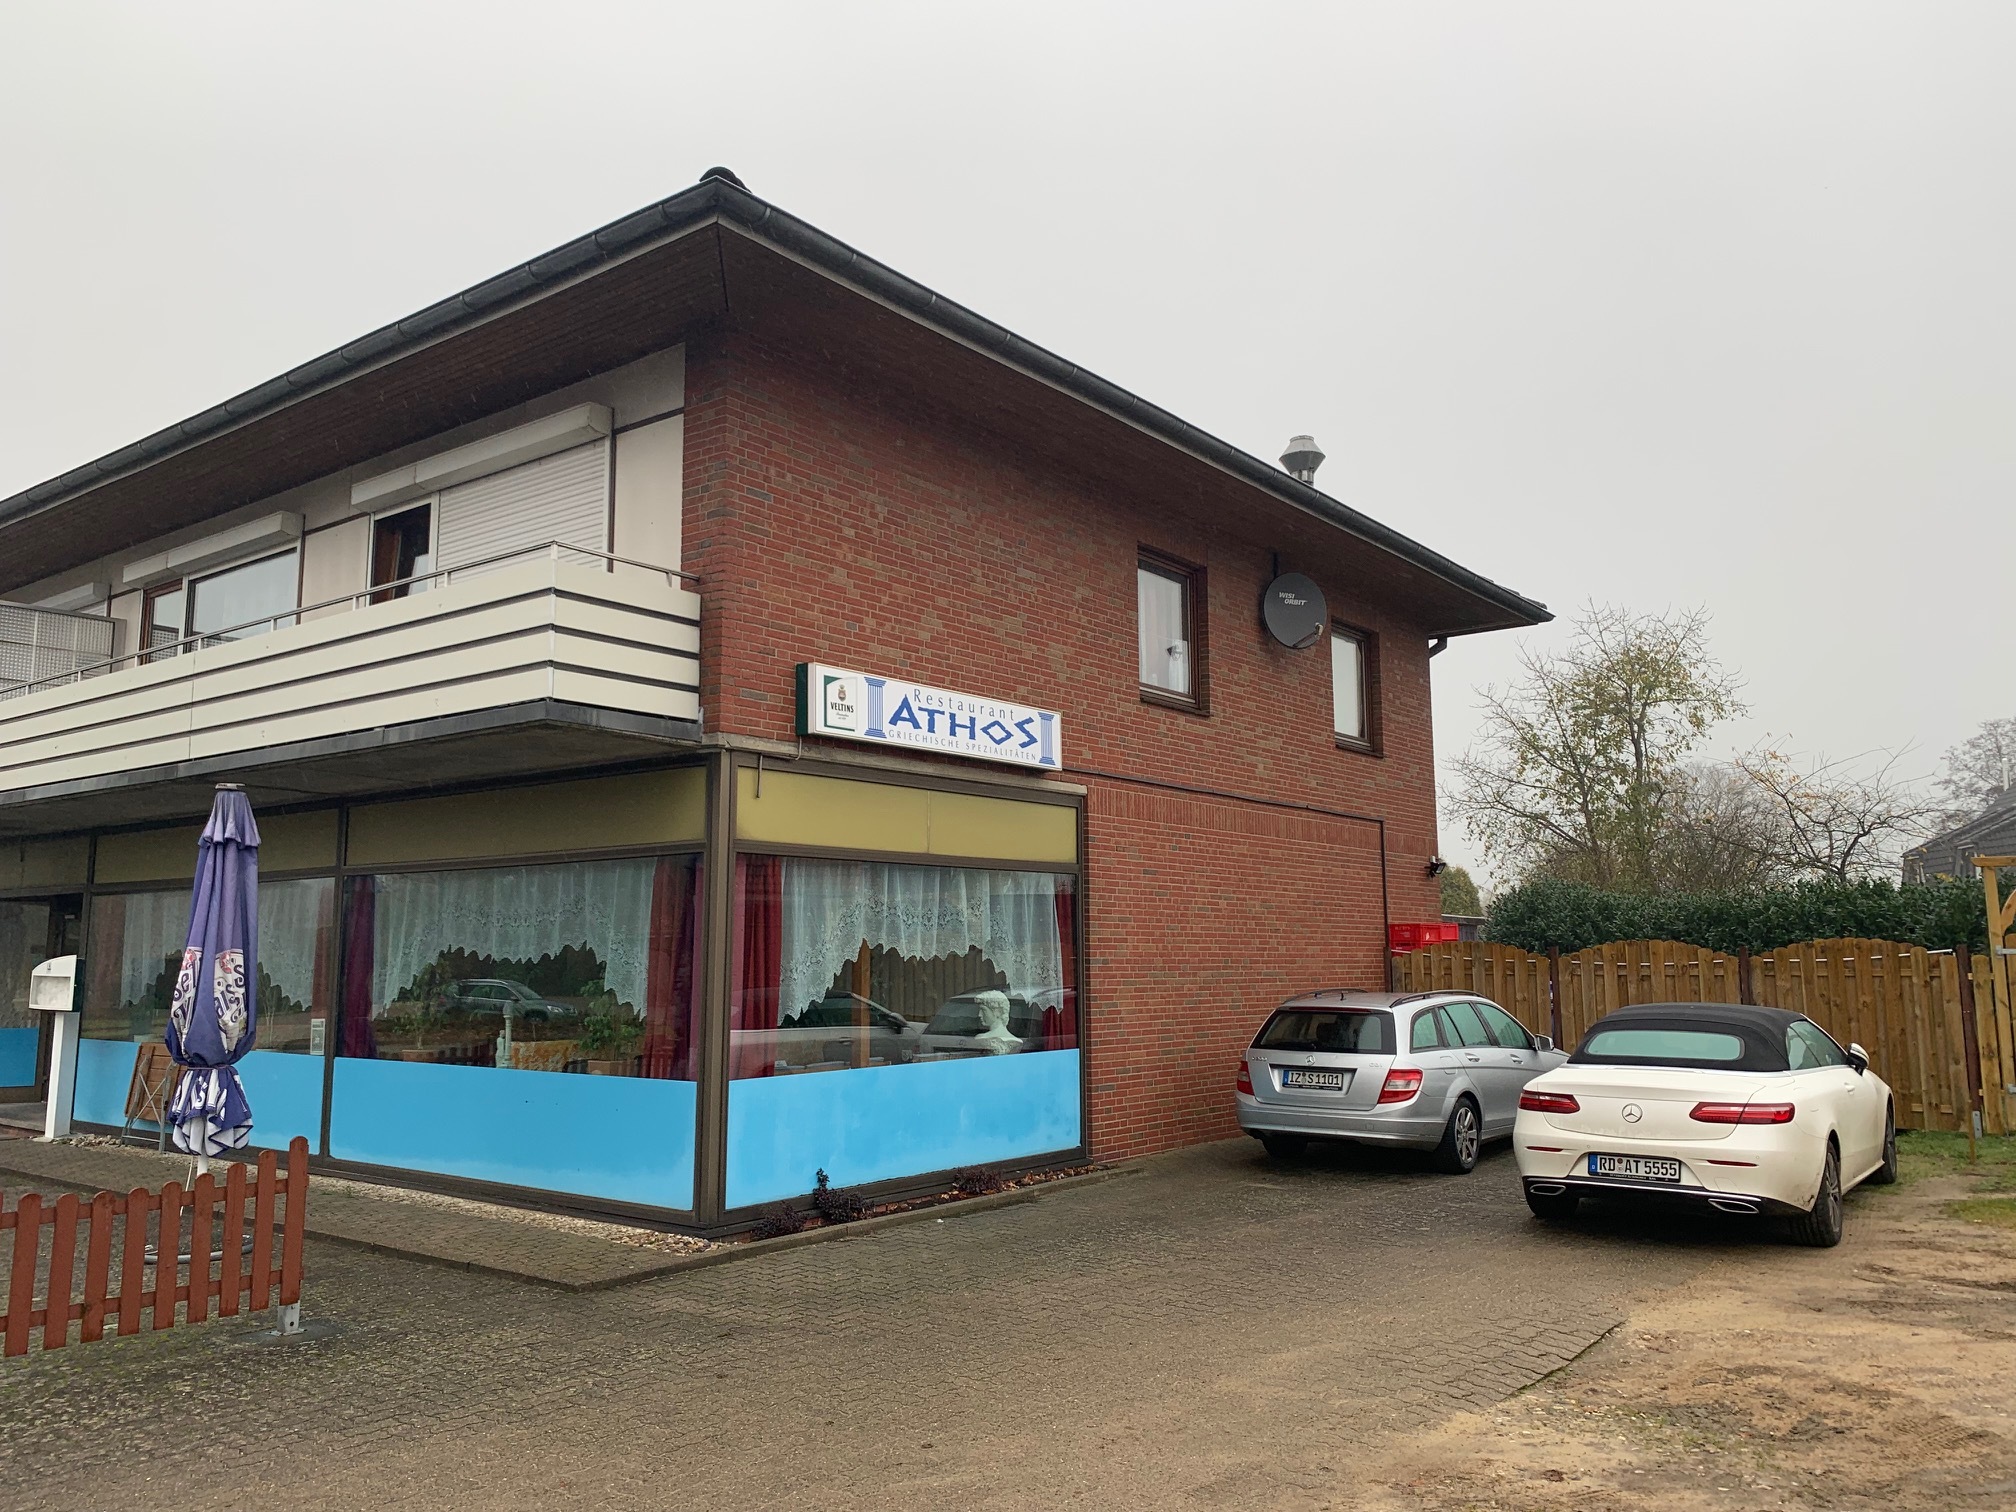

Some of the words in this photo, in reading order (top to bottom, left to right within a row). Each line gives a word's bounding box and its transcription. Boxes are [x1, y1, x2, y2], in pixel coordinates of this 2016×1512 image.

[830, 702, 854, 713] VELTINS
[914, 688, 1015, 721] Restaurant
[888, 694, 1038, 748] ATHOS
[888, 729, 960, 749] GRIECHISCHE
[965, 742, 1036, 761] SPEZIALITÄTEN
[1289, 1073, 1301, 1083] IZ
[1599, 1157, 1616, 1171] RD
[1624, 1159, 1641, 1174] AT
[1644, 1160, 1677, 1176] 5555
